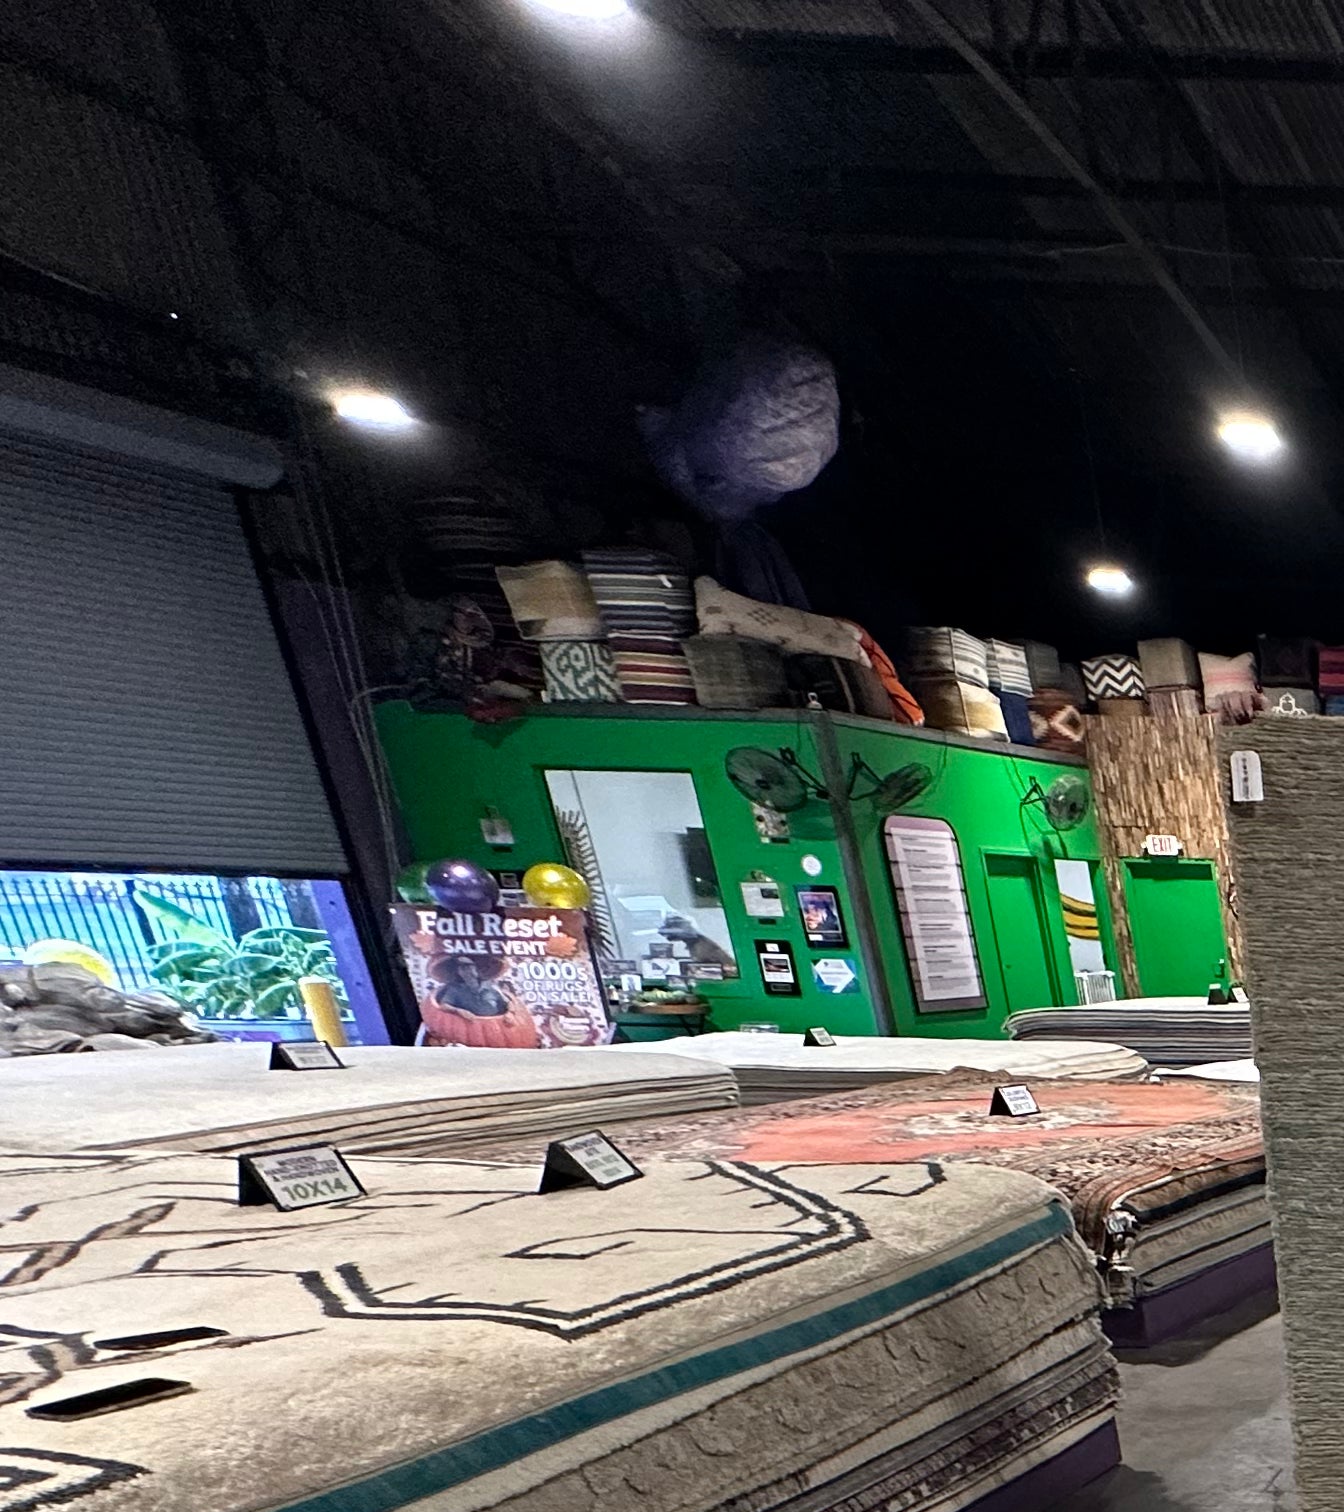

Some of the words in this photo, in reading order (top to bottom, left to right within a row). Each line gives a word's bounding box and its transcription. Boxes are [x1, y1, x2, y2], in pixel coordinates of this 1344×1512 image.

[1152, 837, 1172, 852] EXIT
[416, 911, 476, 936] Fall
[482, 913, 563, 937] Reset
[443, 940, 487, 954] SALE
[491, 941, 547, 956] EVENT
[519, 962, 588, 982] 1000s
[523, 981, 543, 992] OF
[545, 981, 583, 992] RUGS
[525, 992, 547, 1002] ON
[282, 1178, 347, 1201] 10X14
